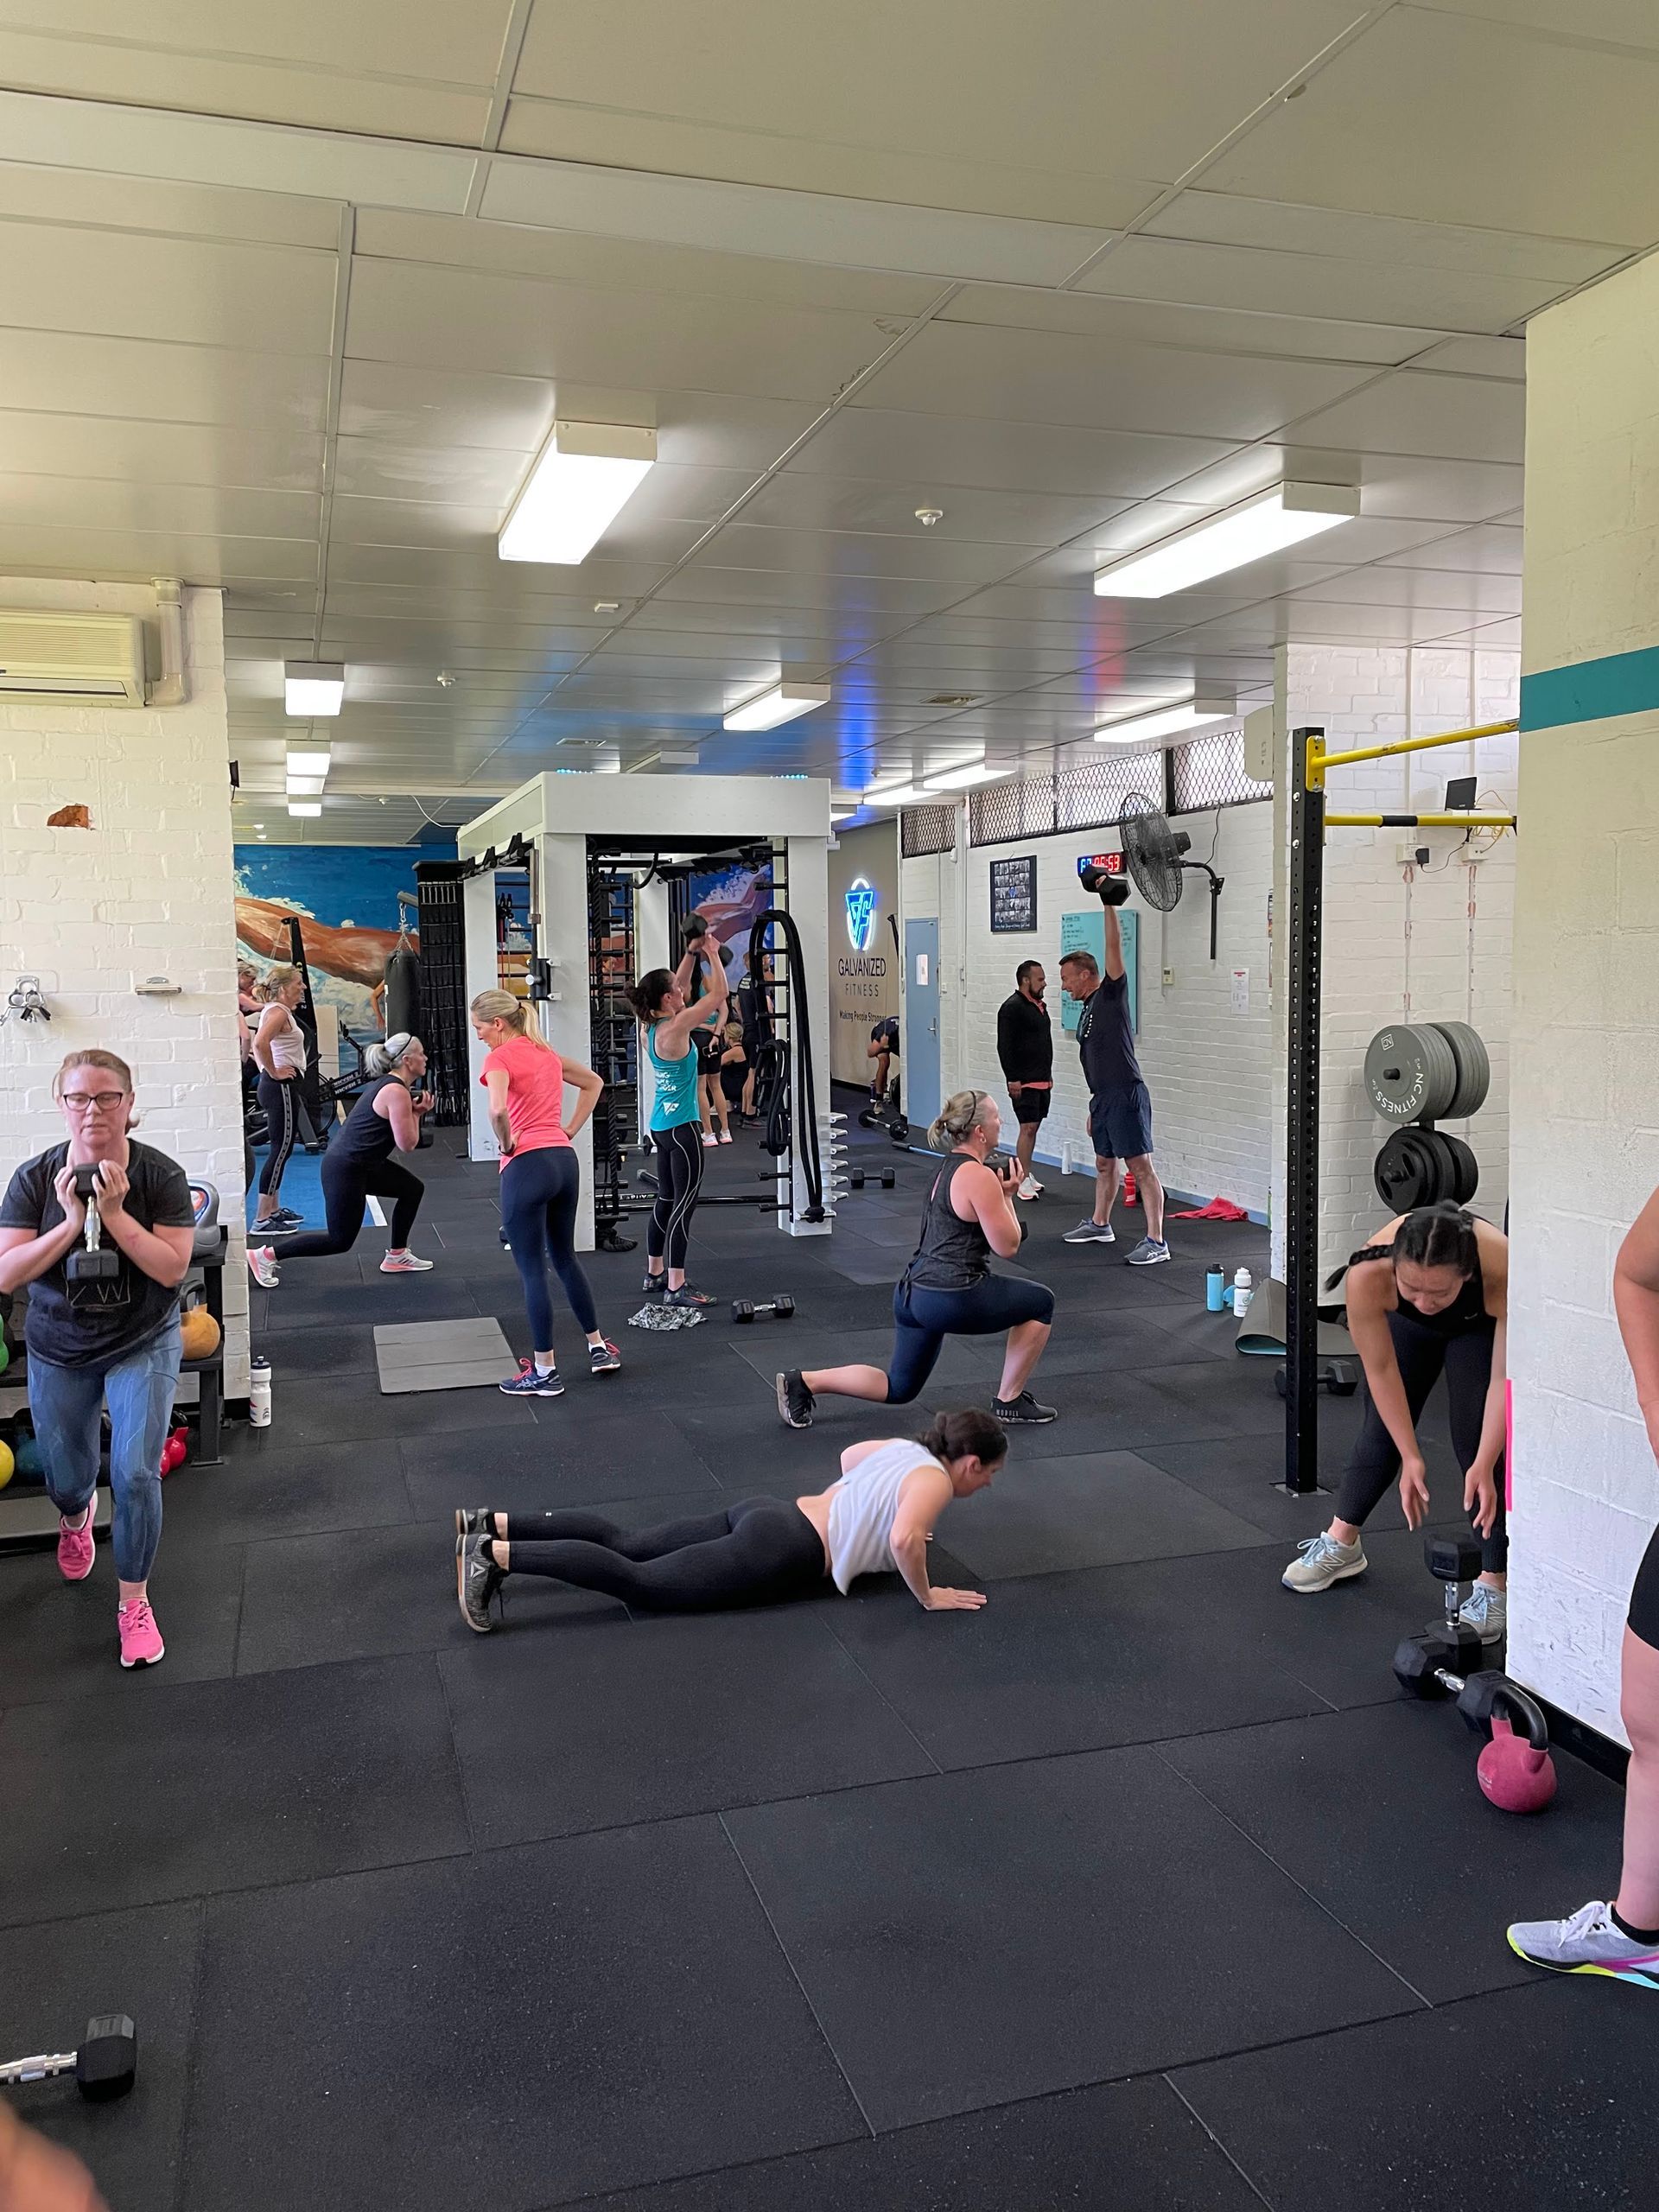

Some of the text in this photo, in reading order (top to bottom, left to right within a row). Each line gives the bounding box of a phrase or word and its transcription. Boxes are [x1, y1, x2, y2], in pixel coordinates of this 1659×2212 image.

[838, 957, 887, 977] GALVANIZED
[845, 983, 879, 997] FITNESS
[1376, 1072, 1424, 1114] NC FITNESS
